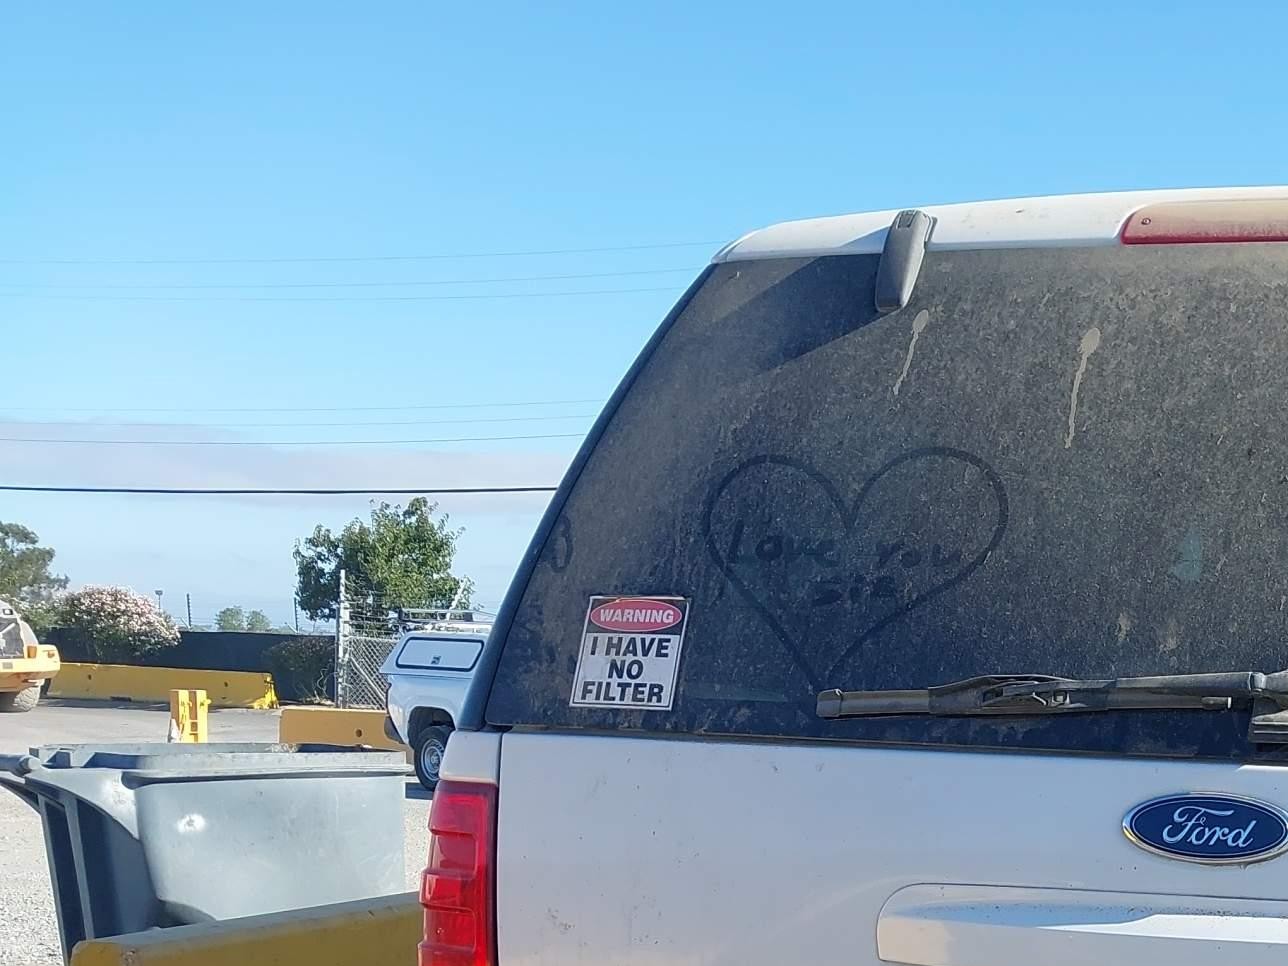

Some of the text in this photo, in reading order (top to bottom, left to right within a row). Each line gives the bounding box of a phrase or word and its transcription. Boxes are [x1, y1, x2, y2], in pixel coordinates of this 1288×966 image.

[600, 609, 674, 624] WARNING
[590, 636, 671, 658] I HAVE
[607, 659, 644, 680] NO
[581, 681, 664, 704] FILTER
[1162, 805, 1257, 848] Ford
